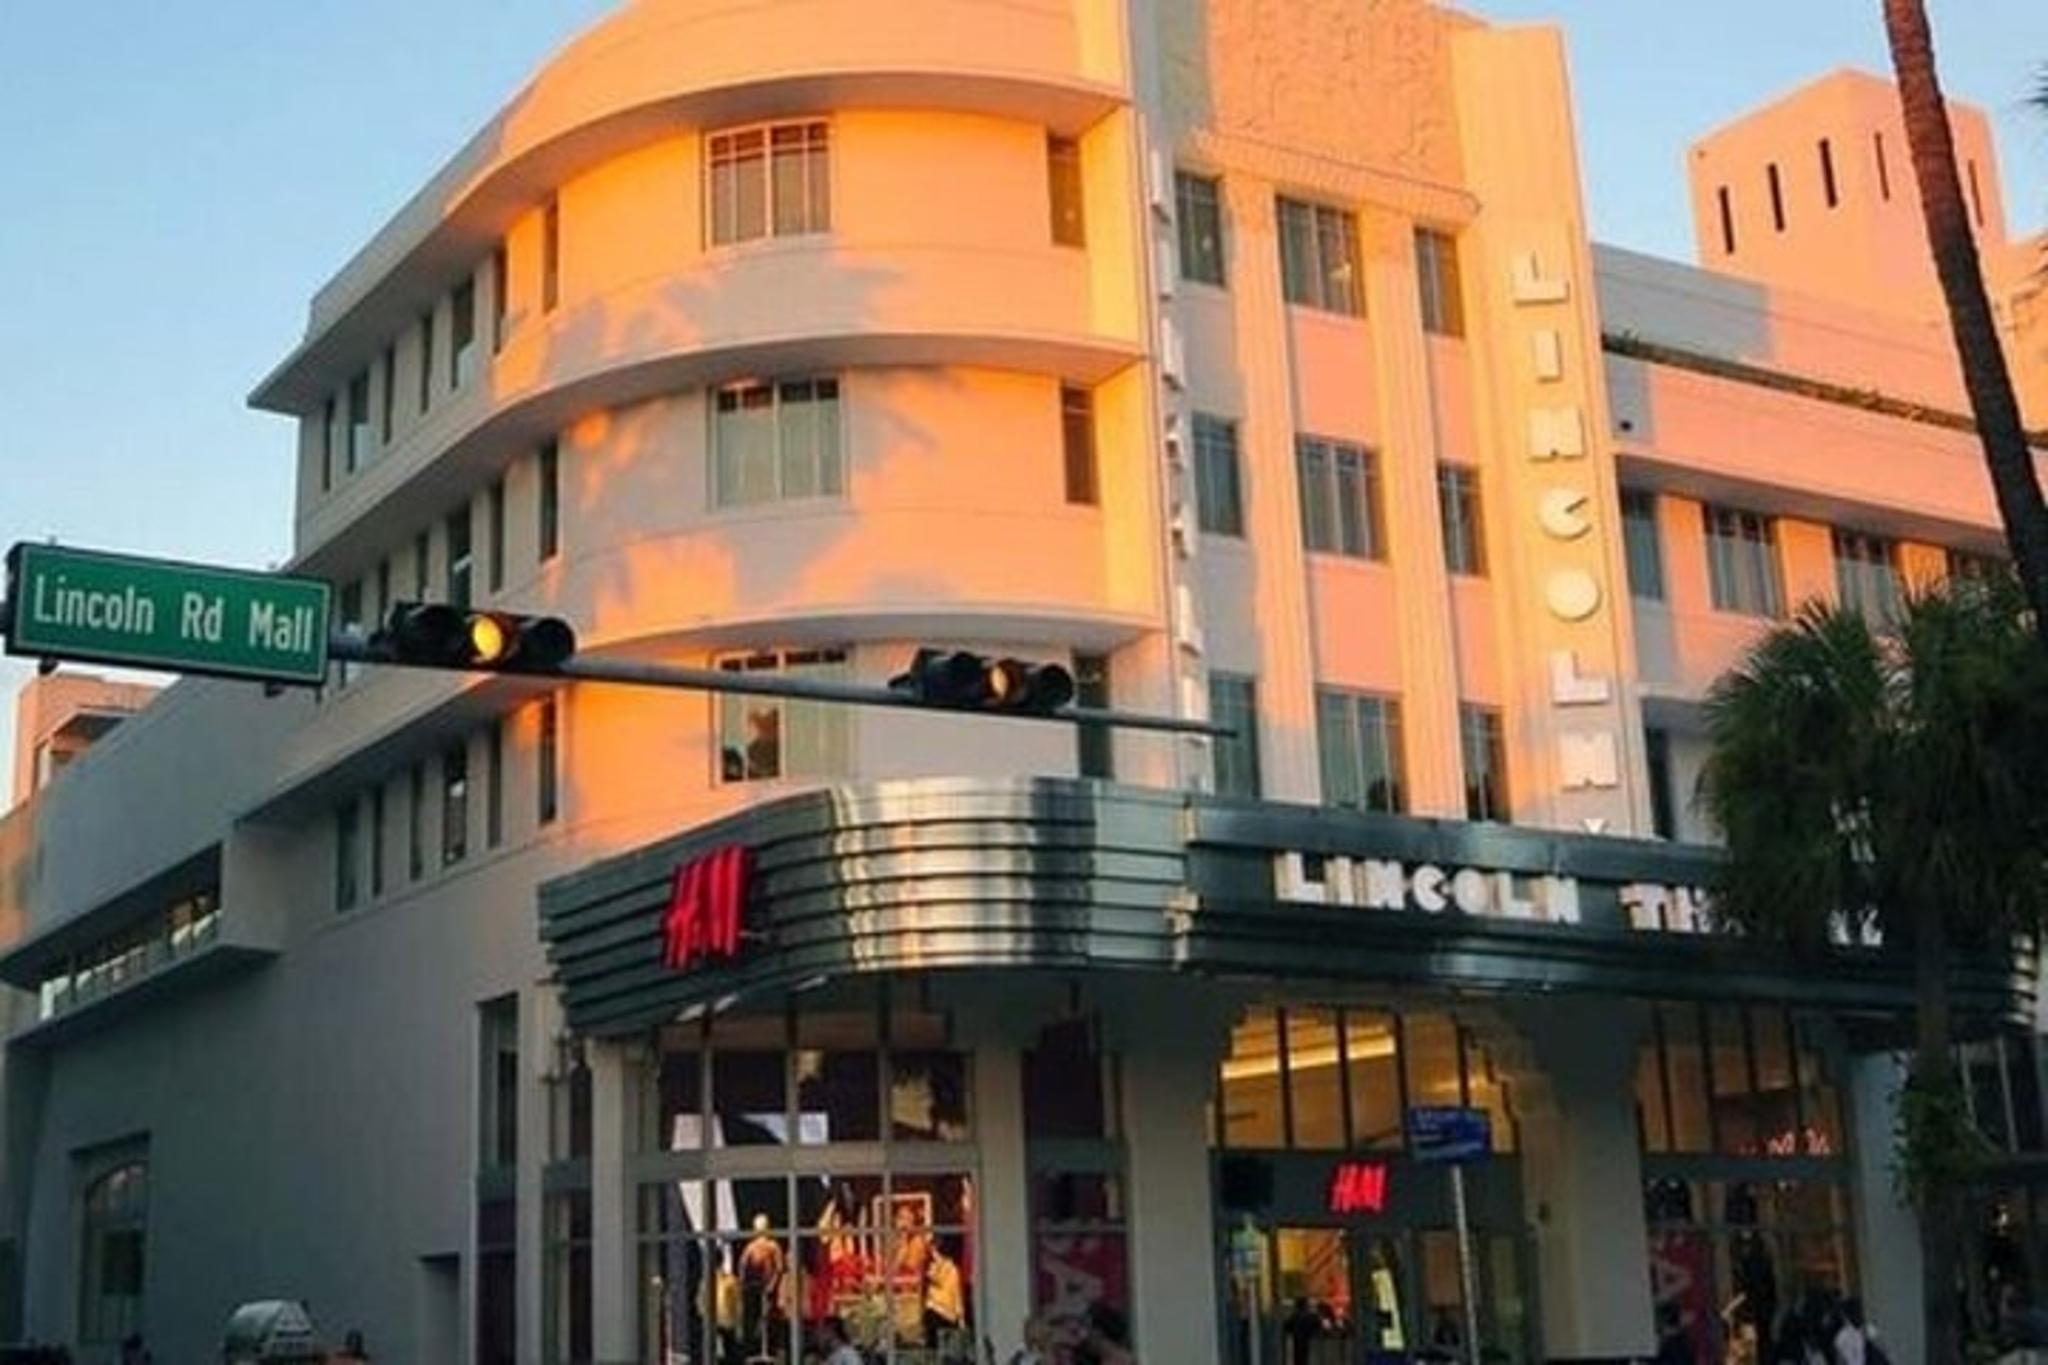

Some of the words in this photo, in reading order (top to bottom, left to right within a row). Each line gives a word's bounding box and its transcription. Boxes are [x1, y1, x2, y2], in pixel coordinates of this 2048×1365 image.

[1513, 250, 1618, 788] LINCOLN
[33, 573, 154, 635] Lincoln
[181, 591, 223, 642] Rd
[249, 600, 313, 654] Mall
[1273, 851, 1581, 924] LINCOLN
